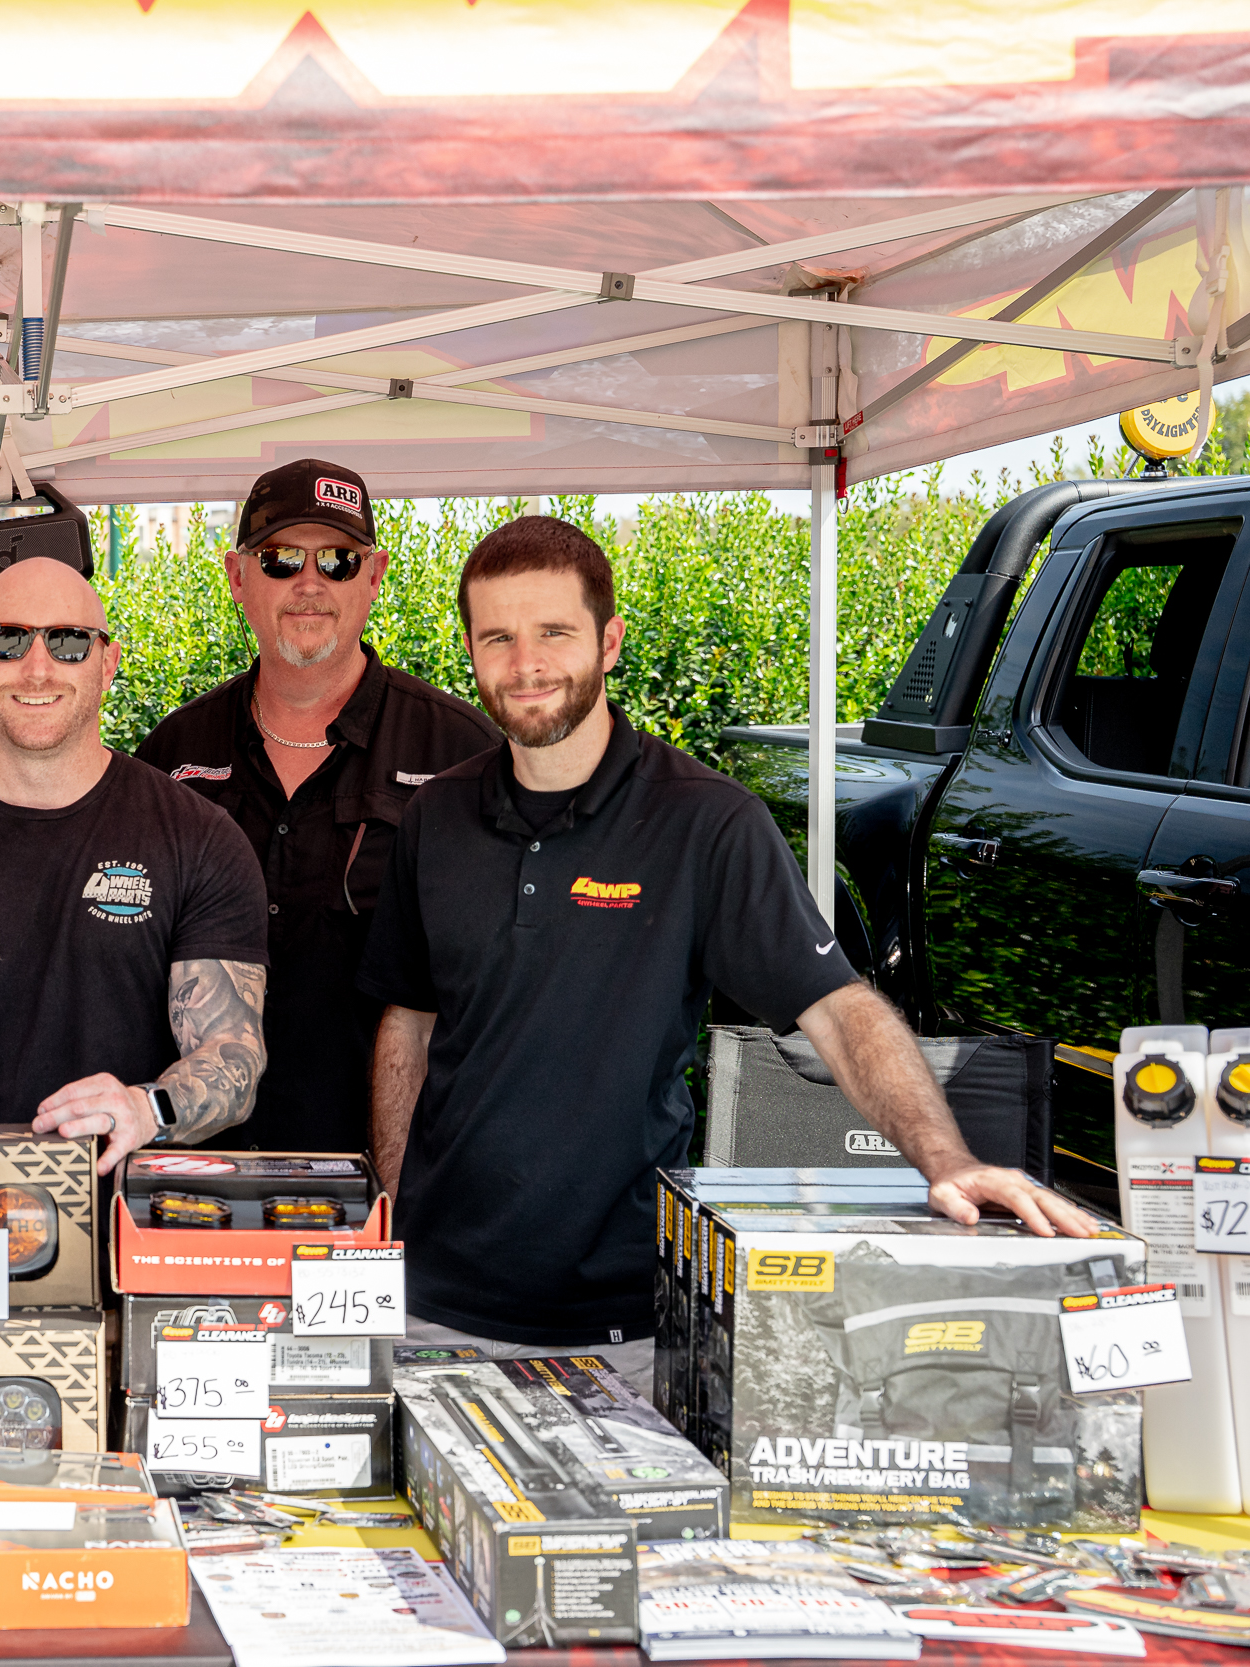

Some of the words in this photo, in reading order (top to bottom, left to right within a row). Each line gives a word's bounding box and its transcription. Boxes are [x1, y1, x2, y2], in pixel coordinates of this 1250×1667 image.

[323, 483, 358, 505] ARB
[97, 860, 120, 870] EST.
[109, 875, 153, 892] WHEEL
[570, 876, 642, 899] 4WP
[106, 888, 152, 906] PARTS
[87, 905, 107, 920] FOUR
[108, 914, 133, 924] WHEEL
[132, 1255, 161, 1265] THE
[164, 1256, 263, 1267] SCIENTISTS
[266, 1257, 286, 1267] OF
[332, 1248, 402, 1260] CLEARANCE
[755, 1255, 827, 1277] SB
[754, 1279, 827, 1287] SMITTYBILT
[1101, 1289, 1176, 1308] CLEARANCE
[196, 1329, 267, 1342] CLEARANCE
[904, 1320, 986, 1344] SB
[750, 1436, 969, 1471] ADVENTURE
[750, 1466, 928, 1488] TRASH/RECOVERY
[928, 1470, 971, 1490] BAG
[22, 1570, 114, 1590] NACHO
